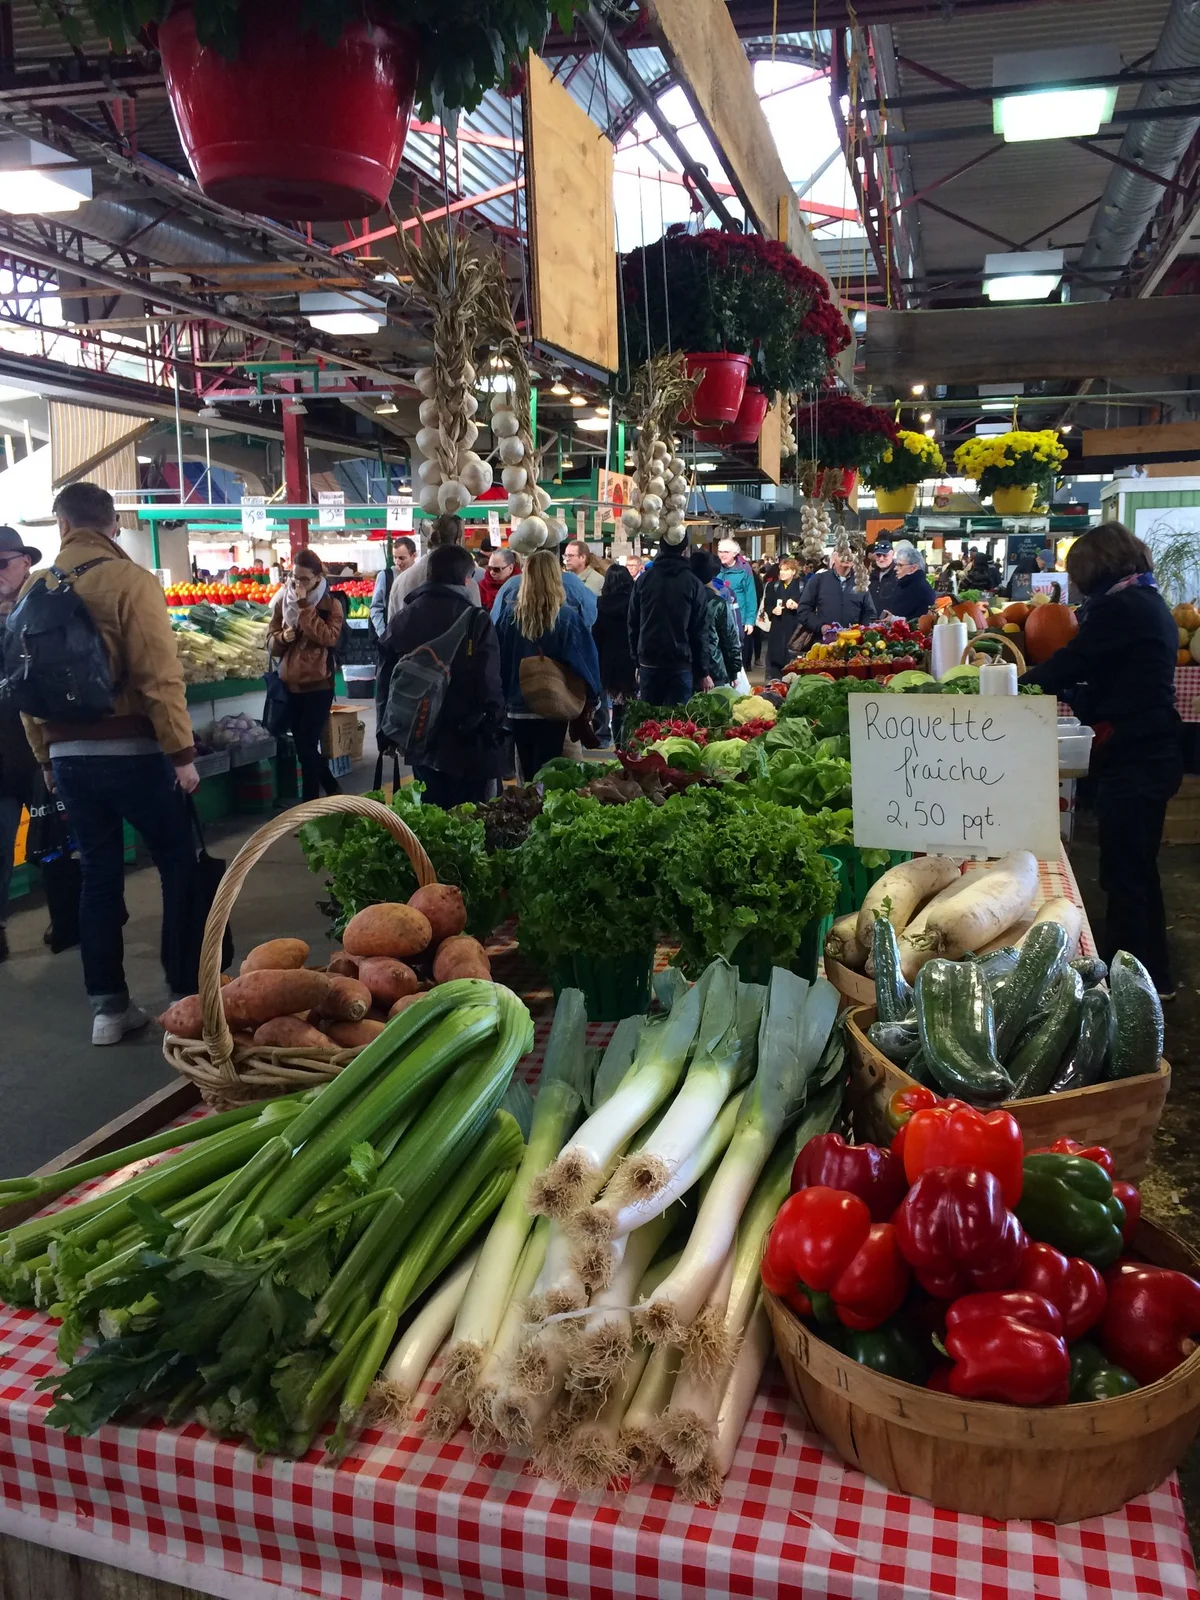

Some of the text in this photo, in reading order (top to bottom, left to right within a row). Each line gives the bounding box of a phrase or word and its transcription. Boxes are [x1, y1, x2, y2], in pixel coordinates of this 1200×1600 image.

[865, 701, 1006, 757] Roquette
[894, 746, 1004, 797] fraîche
[886, 800, 945, 829] 2,50
